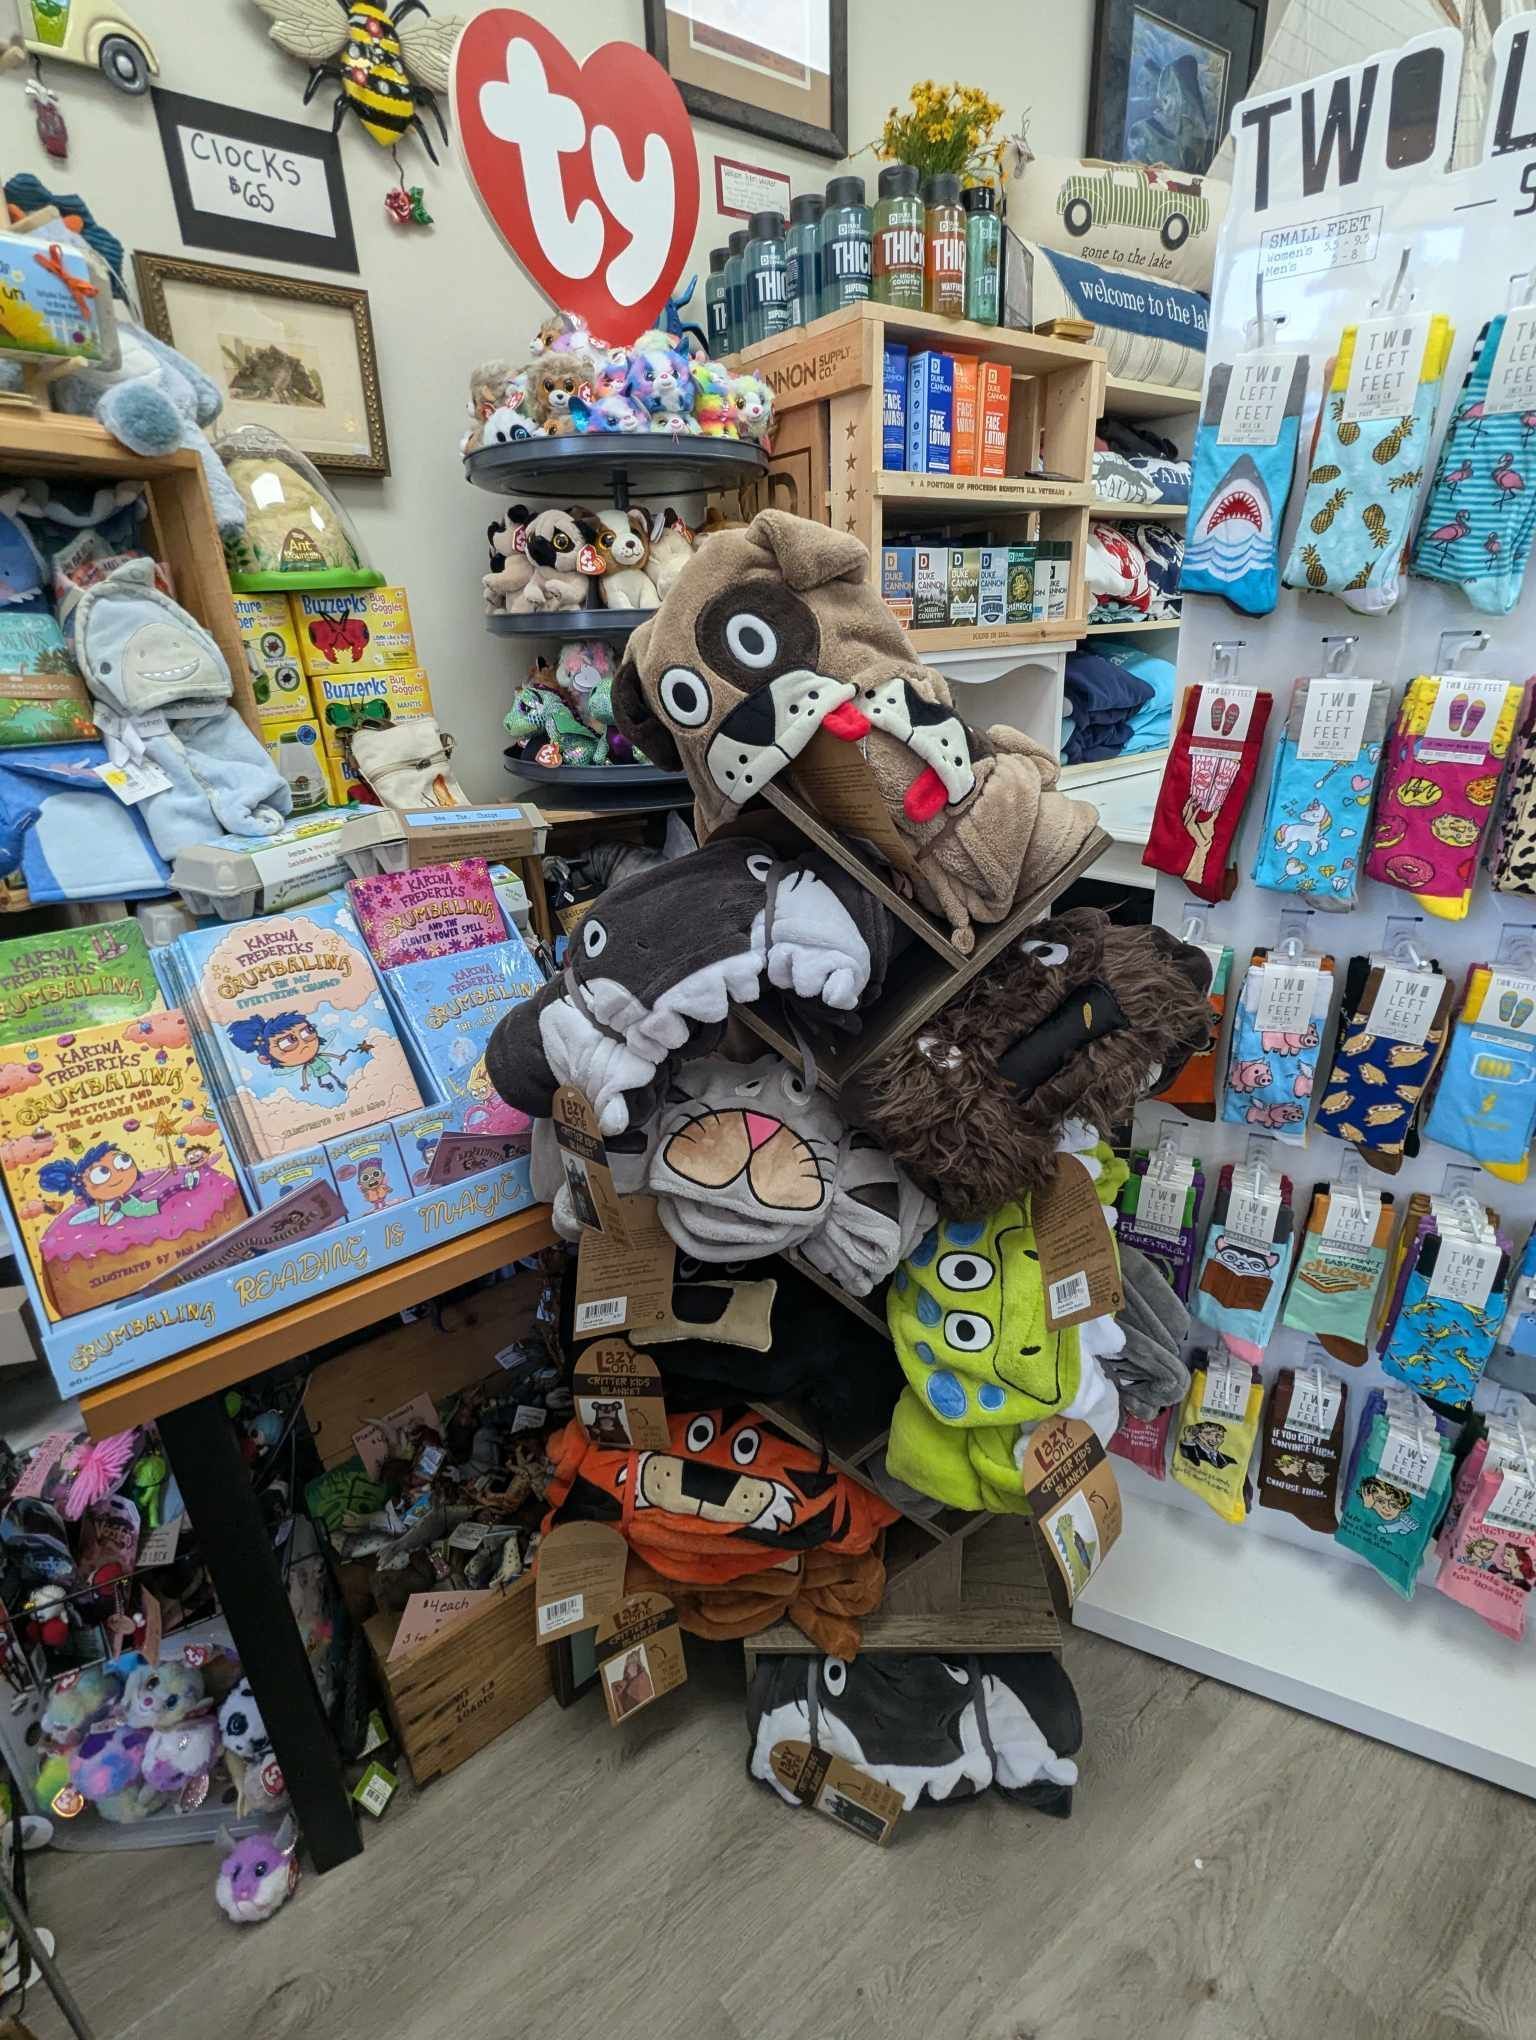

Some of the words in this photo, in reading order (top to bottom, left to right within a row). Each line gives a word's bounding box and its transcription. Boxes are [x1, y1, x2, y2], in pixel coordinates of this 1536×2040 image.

[1242, 47, 1444, 212] TWO
[479, 37, 675, 306] ty
[229, 175, 274, 213] $65
[1269, 227, 1320, 249] SMALL
[1327, 215, 1371, 238] FEET
[882, 231, 926, 266] THICK
[1081, 245, 1111, 260] gone
[1112, 248, 1124, 262] to
[1128, 248, 1146, 266] the
[1149, 250, 1173, 269] lake
[832, 241, 872, 275] THIC
[1080, 278, 1145, 311] welcome
[1148, 296, 1164, 317] to
[1167, 300, 1190, 325] the
[1193, 306, 1209, 331] la
[1369, 328, 1413, 351] TWO
[819, 346, 851, 367] SUPPLY
[1364, 350, 1409, 371] LEFT
[766, 358, 816, 394] NNON
[930, 374, 945, 383] DUKE
[1245, 366, 1282, 383] TWO
[1360, 371, 1406, 392] FEET
[930, 382, 952, 393] CANNON
[1239, 386, 1278, 401] LEFT
[883, 393, 902, 410] FACE
[883, 409, 905, 427] WASH
[1234, 405, 1273, 420] FEET
[929, 414, 945, 431] FACE
[985, 415, 1001, 431] FACE
[929, 430, 951, 447] LOTION
[984, 430, 1006, 446] LOTION
[927, 481, 954, 490] PORTION
[957, 482, 965, 490] OF
[966, 484, 997, 492] PROCEEDS
[999, 486, 1025, 494] BENEFITS
[289, 539, 312, 551] Ant
[283, 551, 320, 562] Mountain
[885, 571, 905, 581] DUKE
[918, 571, 936, 581] DUKE
[951, 568, 969, 578] DUKE
[980, 571, 996, 579] DUKE
[884, 580, 913, 592] CANNON
[918, 581, 944, 590] CANNON
[951, 578, 978, 588] CANNON
[980, 578, 1006, 588] CANNON
[301, 593, 367, 615] Buzzerks
[369, 592, 386, 602] Bug
[371, 602, 403, 615] Goggles
[918, 612, 945, 621] COUNTRY
[323, 677, 388, 700] Buzzerks
[389, 675, 406, 685] Bug
[391, 684, 423, 695] Goggles
[1463, 681, 1482, 691] LEFT
[1484, 683, 1503, 693] FEET
[1320, 692, 1357, 707] TWO
[1316, 710, 1354, 723] LEFT
[1313, 726, 1351, 739] FEET
[406, 872, 453, 893] KARINA
[400, 886, 466, 908] FREDERIKS
[428, 921, 443, 931] AND
[444, 917, 458, 929] THE
[243, 928, 299, 953] KARINA
[401, 934, 431, 948] FLOWER
[433, 929, 459, 942] POWER
[462, 921, 485, 935] SPELL
[10, 945, 79, 972] KARINA
[236, 942, 314, 968] FREDERIKS
[1, 961, 97, 992] FREDERIKS
[452, 962, 493, 983] KARINA
[449, 973, 506, 994] FREDERIKS
[1273, 977, 1305, 990] TWO
[1395, 980, 1432, 999] TWO
[1270, 992, 1305, 1003] LEFT
[1389, 994, 1426, 1011] LEFT
[1267, 1005, 1300, 1017] FEET
[1384, 1009, 1422, 1025] FEET
[56, 1039, 124, 1068] KARINA
[44, 1053, 141, 1087] FREDERIKS
[68, 1100, 127, 1119] MITCHY
[129, 1088, 153, 1103] AND
[56, 1120, 83, 1133] THE
[85, 1106, 134, 1126] GOLDEN
[137, 1095, 172, 1110] WAND
[1150, 1188, 1177, 1204] TWO
[1147, 1199, 1176, 1213] LEFT
[1239, 1199, 1268, 1217] TWO
[1340, 1206, 1371, 1219] TWO
[1144, 1210, 1173, 1225] FEET
[1236, 1211, 1266, 1227] LEFT
[1336, 1218, 1366, 1232] LEFT
[1234, 1222, 1264, 1239] FEET
[1333, 1230, 1364, 1242] FEET
[234, 1235, 369, 1308] READING
[383, 1222, 407, 1249] IS
[418, 1172, 522, 1232] MAGIC
[1325, 1257, 1350, 1268] EASY
[1350, 1262, 1379, 1275] BEING
[1451, 1251, 1487, 1269] TWO
[89, 1259, 153, 1289] ILLUSTRATED
[156, 1252, 171, 1265] BY
[1305, 1258, 1376, 1290] cheesy
[1446, 1264, 1483, 1282] LEFT
[1441, 1275, 1480, 1292] FEET
[587, 1375, 628, 1386] CRITTER
[629, 1376, 651, 1388] KIDS
[1272, 1428, 1280, 1438] IF
[1281, 1430, 1297, 1441] YOU
[1271, 1437, 1311, 1454] CONVINCE
[1040, 1458, 1074, 1494] CRITTER
[1072, 1443, 1092, 1465] KIDS
[1055, 1461, 1089, 1498] BLANKET
[1265, 1476, 1300, 1494] CONFUSE
[1452, 1570, 1470, 1583] too
[439, 1597, 470, 1613] each
